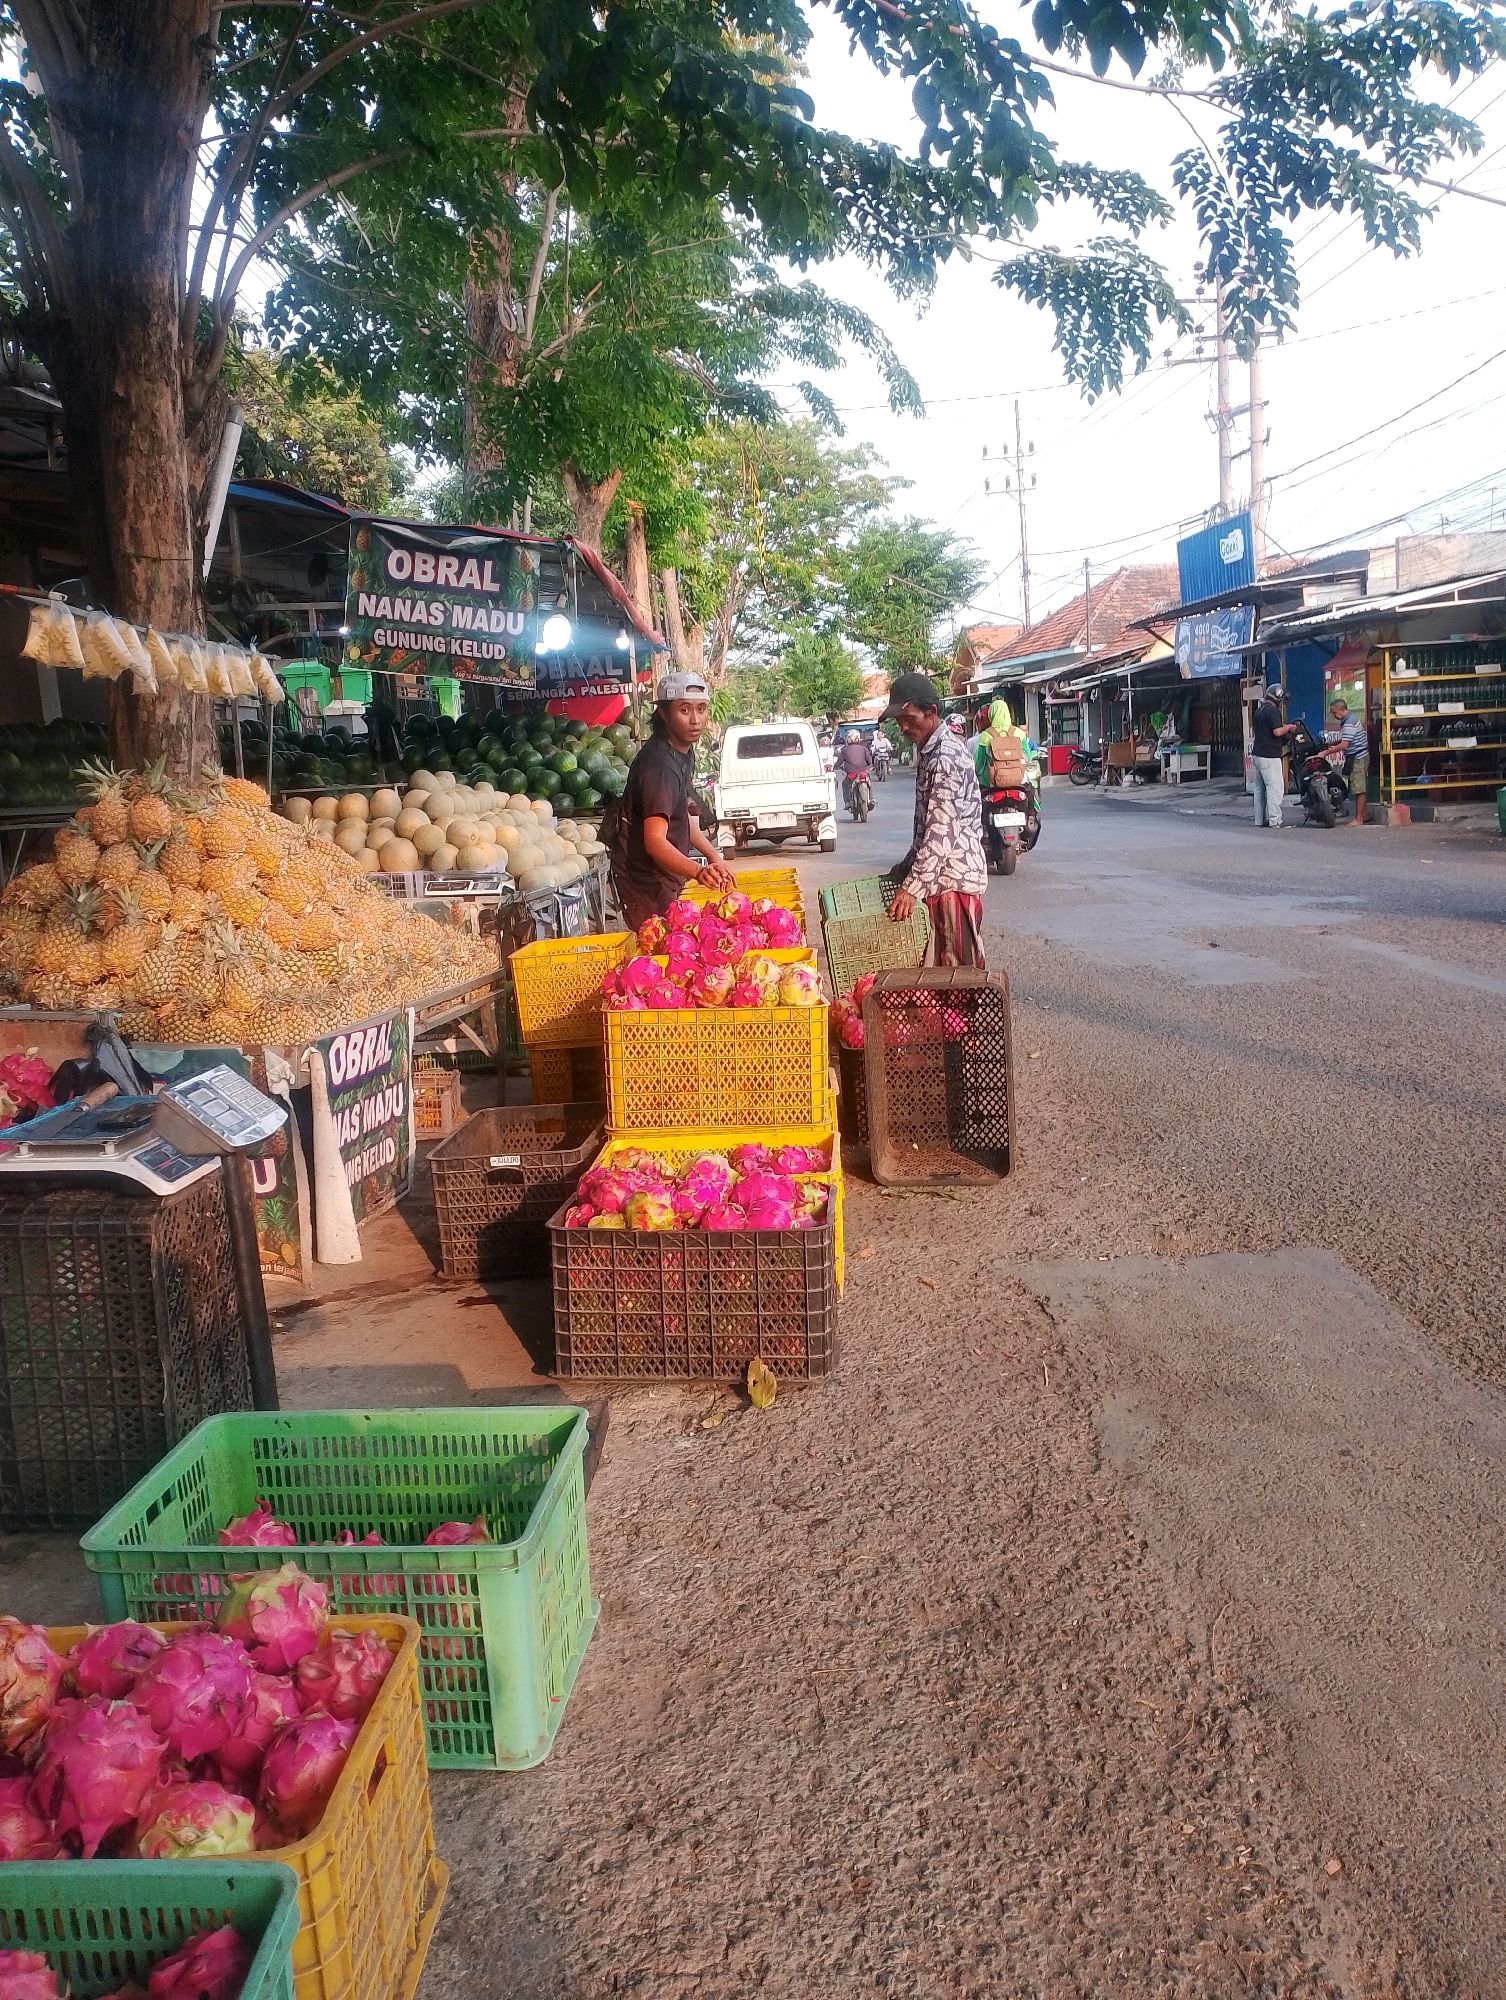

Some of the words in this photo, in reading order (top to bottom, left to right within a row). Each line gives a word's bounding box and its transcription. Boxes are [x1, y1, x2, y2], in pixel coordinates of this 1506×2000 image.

[387, 549, 501, 592] OBRAL
[358, 593, 445, 626] NANAS
[452, 605, 525, 635] MADU
[373, 628, 446, 654] GUNUNG
[450, 638, 506, 660] KELUD
[506, 687, 576, 701] SEMANGKA
[328, 1020, 393, 1086] OBRAL
[333, 1103, 360, 1147] NAS
[363, 1082, 404, 1133] MADU
[362, 1136, 396, 1177] KELUD
[260, 1264, 272, 1272] an
